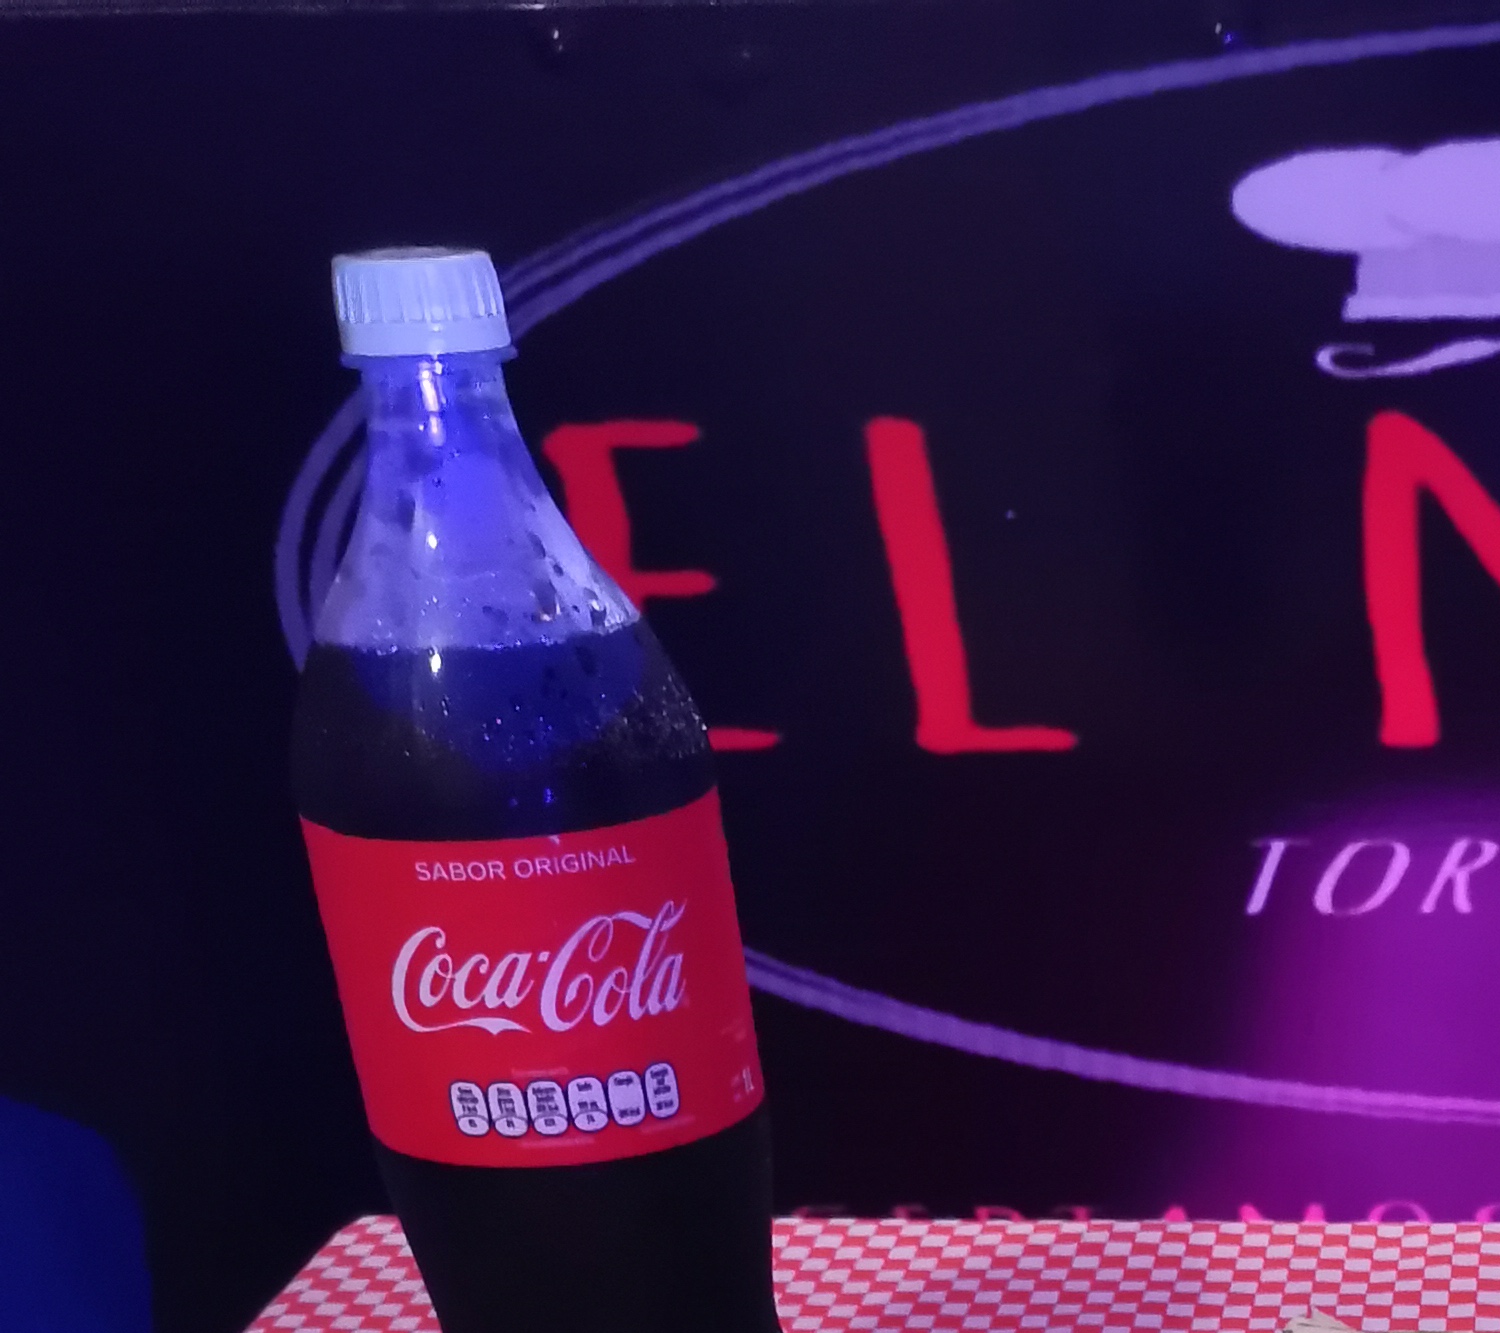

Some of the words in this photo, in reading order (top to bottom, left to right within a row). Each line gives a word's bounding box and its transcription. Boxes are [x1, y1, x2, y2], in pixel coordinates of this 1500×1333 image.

[541, 414, 1079, 755] EL
[415, 860, 507, 883] SABOR
[514, 844, 637, 880] ORIGINAL
[391, 898, 689, 1035] Coca-Cola
